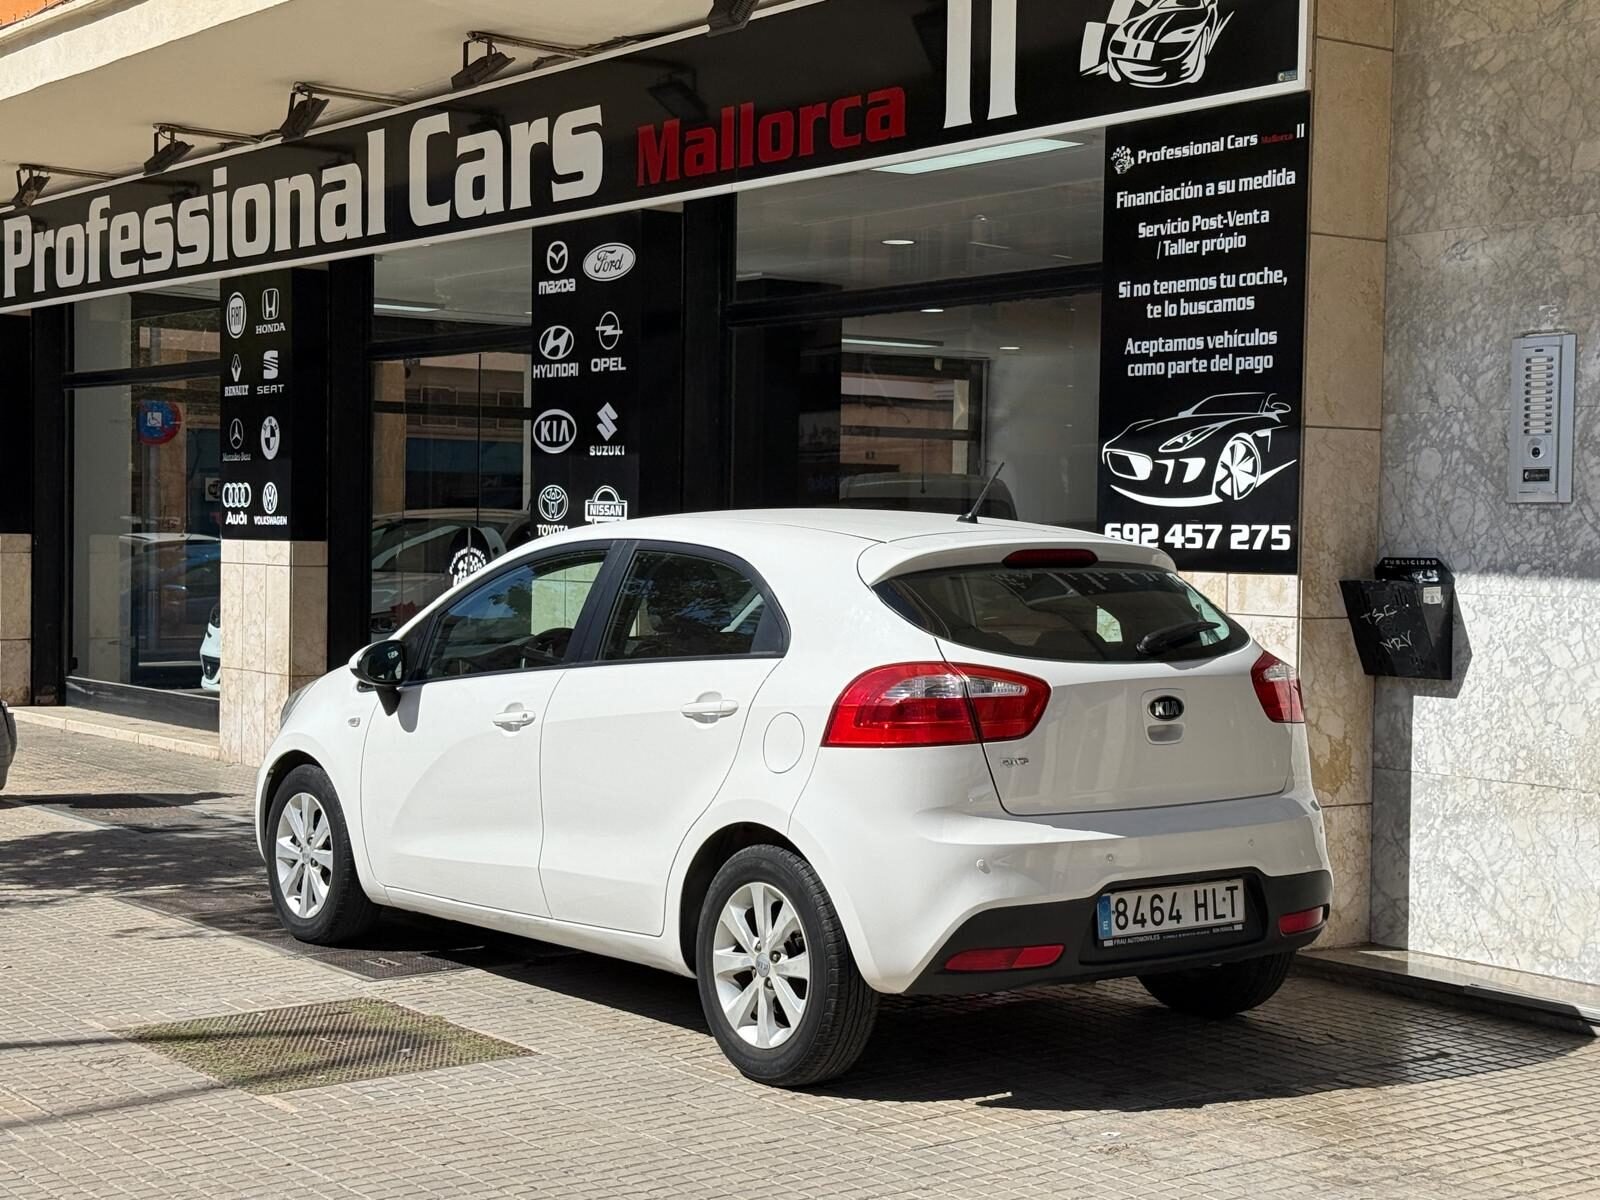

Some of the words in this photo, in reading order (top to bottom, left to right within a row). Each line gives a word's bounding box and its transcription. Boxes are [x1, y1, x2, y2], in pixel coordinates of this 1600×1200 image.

[1138, 136, 1224, 164] Professional
[1227, 132, 1258, 150] Cars
[3, 128, 387, 298] Professional
[409, 105, 602, 227] Cars
[636, 86, 907, 187] Mallorca
[1116, 181, 1203, 208] Financiación
[1206, 182, 1215, 196] a
[1218, 178, 1236, 195] su
[1239, 168, 1296, 193] medida
[1138, 217, 1190, 239] Servicio
[1192, 209, 1270, 234] Post-Venta
[1163, 238, 1200, 257] Taller
[1202, 233, 1247, 256] própio
[594, 249, 624, 273] Ford
[1118, 281, 1131, 299] Si
[1134, 282, 1150, 297] no
[1153, 274, 1217, 296] tenemos
[1220, 272, 1236, 289] tu
[1239, 267, 1288, 287] coche,
[1147, 303, 1162, 319] te
[1164, 301, 1177, 317] lo
[1180, 295, 1255, 316] buscamos
[255, 322, 286, 334] HONDA
[1124, 335, 1205, 358] Aceptamos
[1207, 328, 1278, 350] vehículos
[533, 362, 579, 378] HYUNDAI
[590, 357, 627, 372] OPEL
[1127, 360, 1165, 377] como
[1167, 357, 1208, 379] parte
[1210, 354, 1233, 373] del
[1235, 355, 1273, 375] pago
[224, 384, 249, 397] RENAULT
[256, 384, 285, 395] SEAT
[540, 420, 570, 442] KIA
[589, 445, 625, 456] SUZUKI
[225, 511, 247, 525] Audi
[253, 515, 288, 526] VOLKSWAGEN
[589, 504, 622, 516] NISSAN
[1104, 523, 1159, 547] 692
[1164, 524, 1223, 549] 457
[1230, 524, 1291, 550] 275
[1154, 701, 1180, 716] KIA
[1115, 892, 1182, 930] 8464
[1194, 886, 1239, 922] HLT
